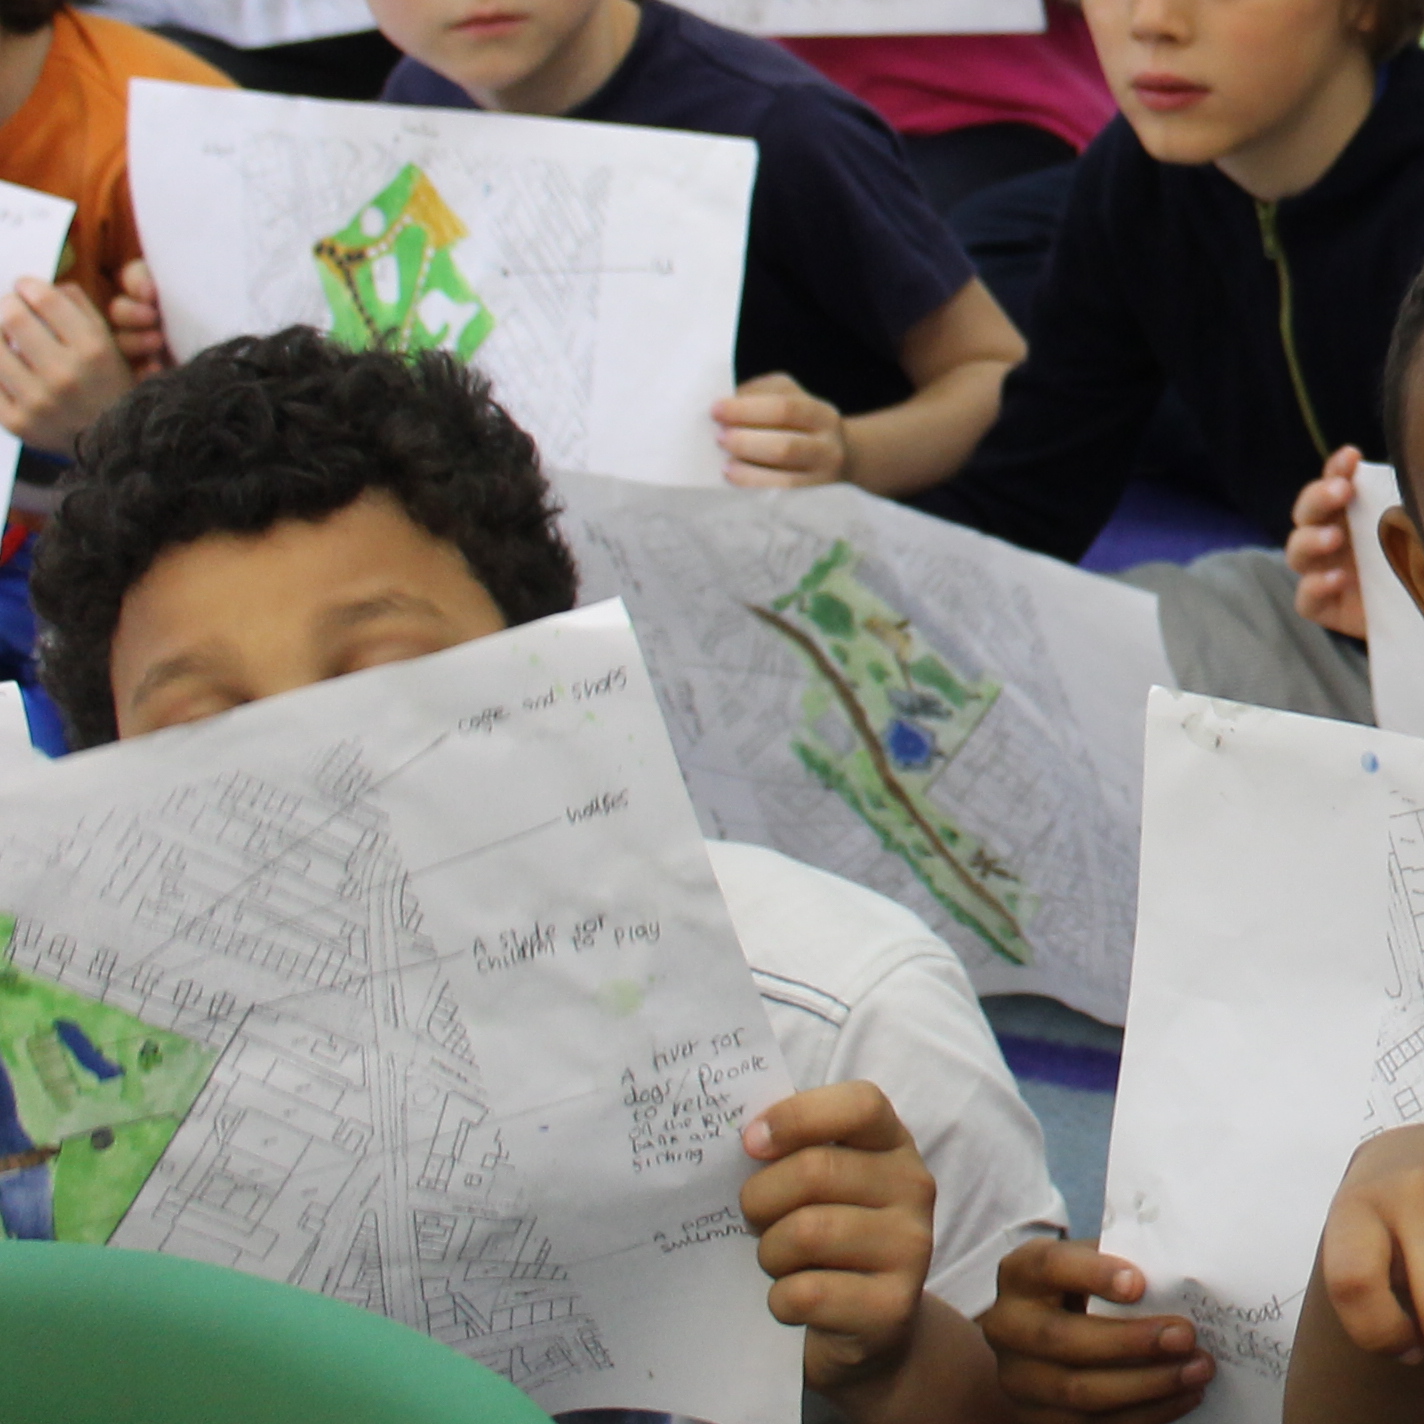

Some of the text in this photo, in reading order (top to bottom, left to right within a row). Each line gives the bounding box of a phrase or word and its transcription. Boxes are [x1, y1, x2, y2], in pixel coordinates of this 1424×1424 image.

[613, 920, 661, 949] play
[620, 1067, 636, 1088] A
[632, 1106, 659, 1124] to
